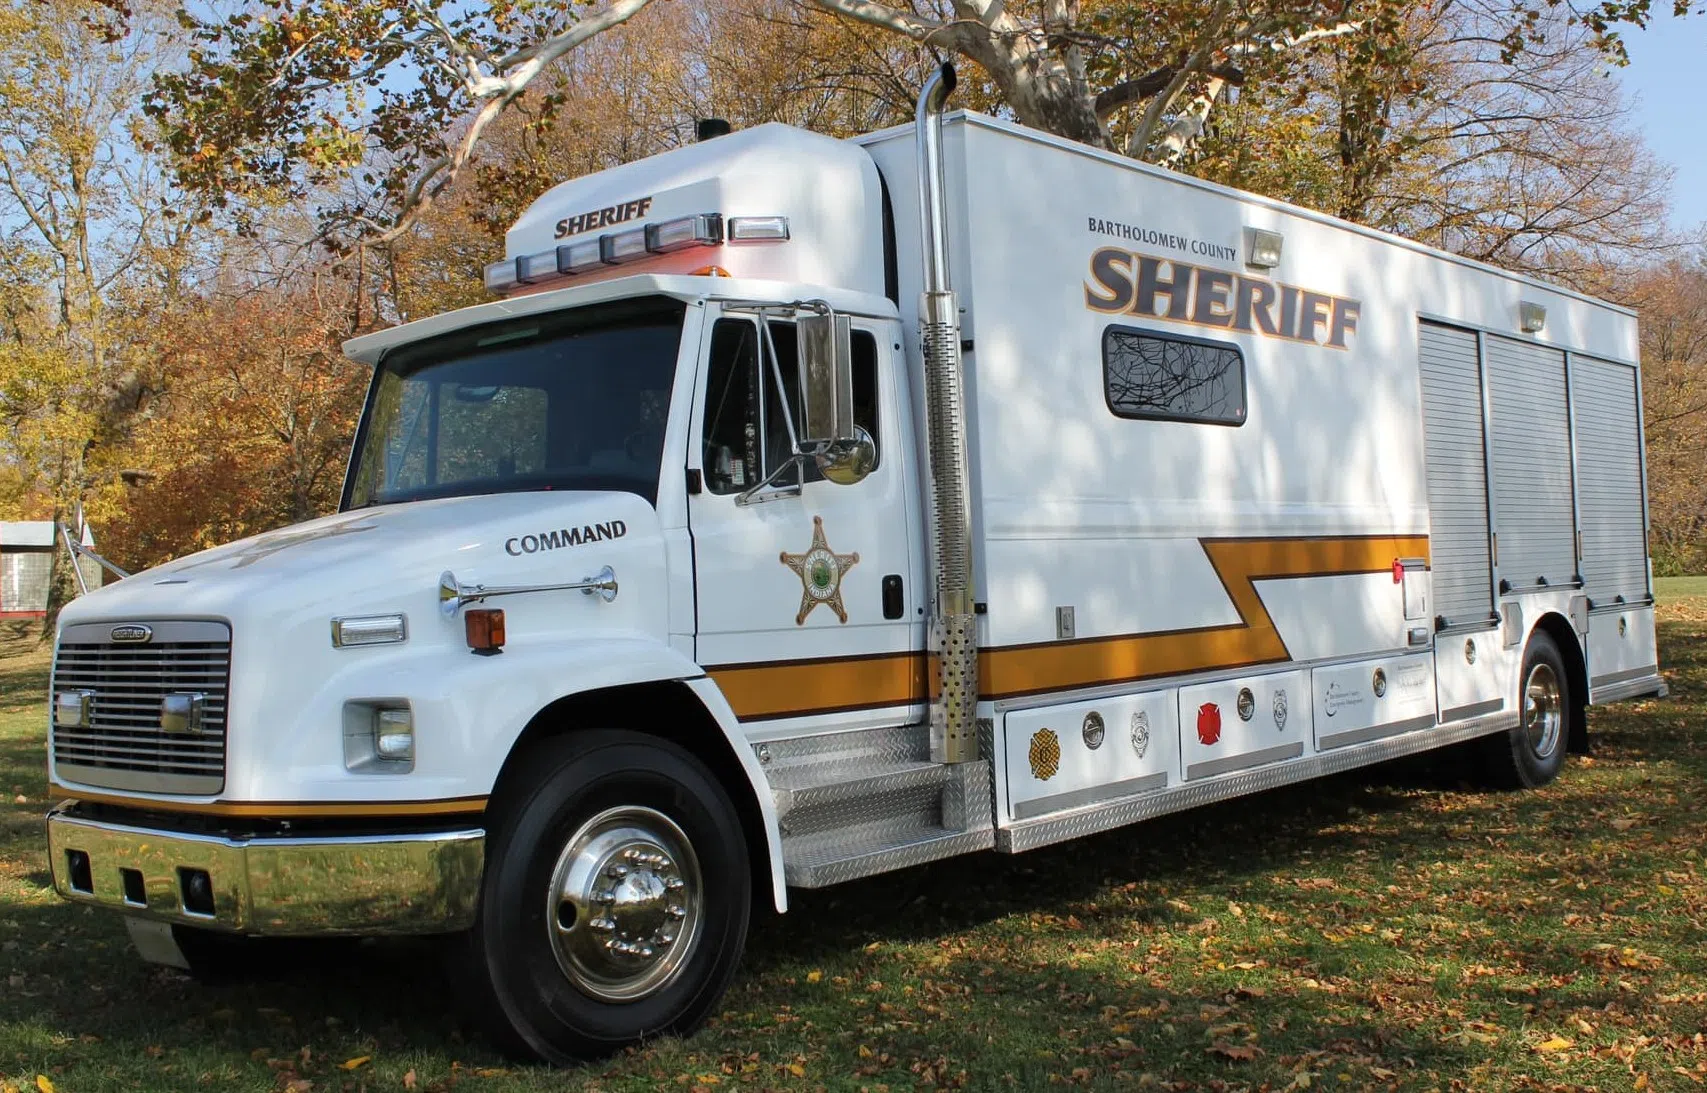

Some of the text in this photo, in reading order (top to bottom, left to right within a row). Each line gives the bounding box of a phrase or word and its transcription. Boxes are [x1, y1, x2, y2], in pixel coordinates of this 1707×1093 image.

[554, 196, 652, 239] SHERIFF
[1088, 217, 1236, 261] BARTHOLOMEW COUNTY
[1083, 246, 1362, 350] SHERIFF
[505, 520, 626, 556] COMMAND
